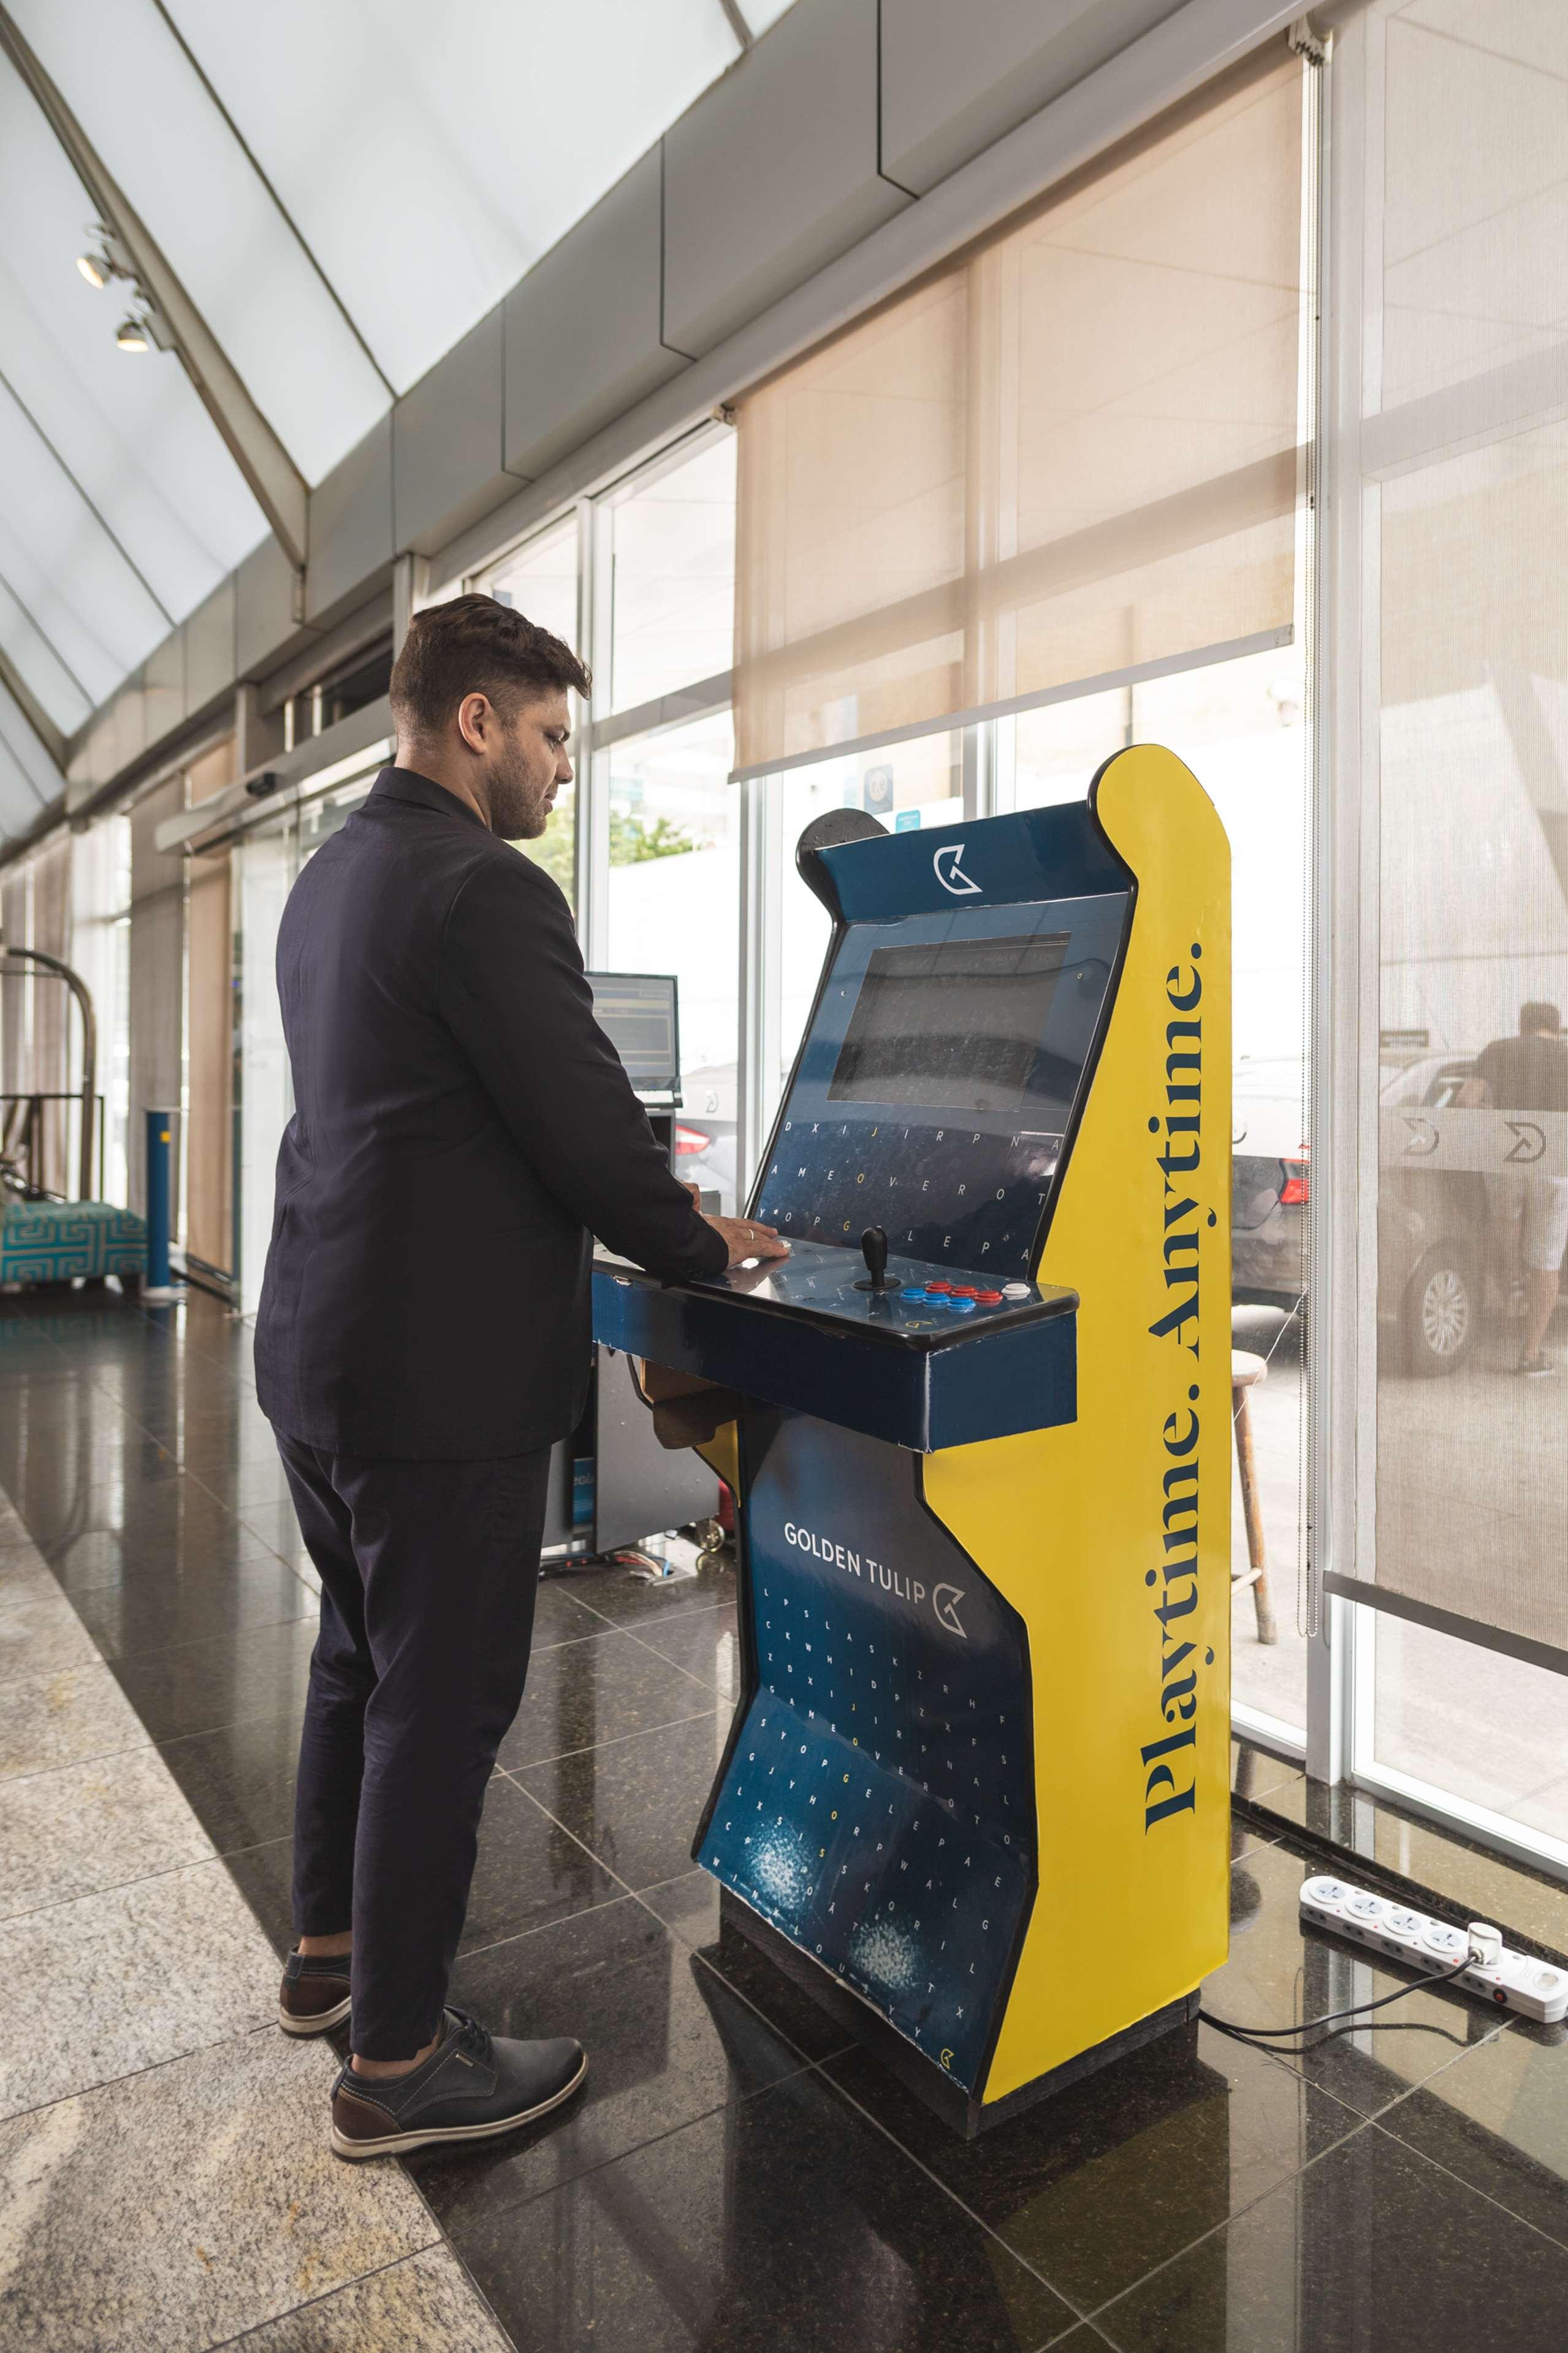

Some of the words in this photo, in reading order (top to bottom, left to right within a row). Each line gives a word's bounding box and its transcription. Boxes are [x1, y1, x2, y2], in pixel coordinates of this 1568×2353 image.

[785, 1122, 791, 1131] D
[812, 1123, 819, 1133] X
[841, 1125, 847, 1135] I
[872, 1127, 877, 1136] J
[904, 1129, 908, 1138] I
[937, 1131, 943, 1141] R
[973, 1134, 980, 1143] P
[1011, 1136, 1019, 1146] N
[1051, 1139, 1058, 1150] A
[1148, 943, 1217, 1361] Anytime.
[771, 1165, 777, 1174] A
[798, 1168, 806, 1177] M
[828, 1171, 834, 1180] E
[858, 1174, 864, 1183] O
[890, 1177, 896, 1187] V
[923, 1180, 929, 1191] E
[958, 1185, 965, 1195] R
[997, 1189, 1004, 1199] O
[1038, 1193, 1045, 1204] T
[760, 1208, 766, 1218] Y
[785, 1212, 791, 1222] O
[814, 1217, 820, 1225] P
[843, 1221, 850, 1231] G
[908, 1231, 912, 1241] L
[944, 1236, 951, 1247] E
[982, 1242, 989, 1253] P
[1021, 1249, 1028, 1260] A
[785, 1522, 860, 1576] GOLDEN
[866, 1559, 925, 1603] TULIP
[1141, 1384, 1214, 1834] Playtime.
